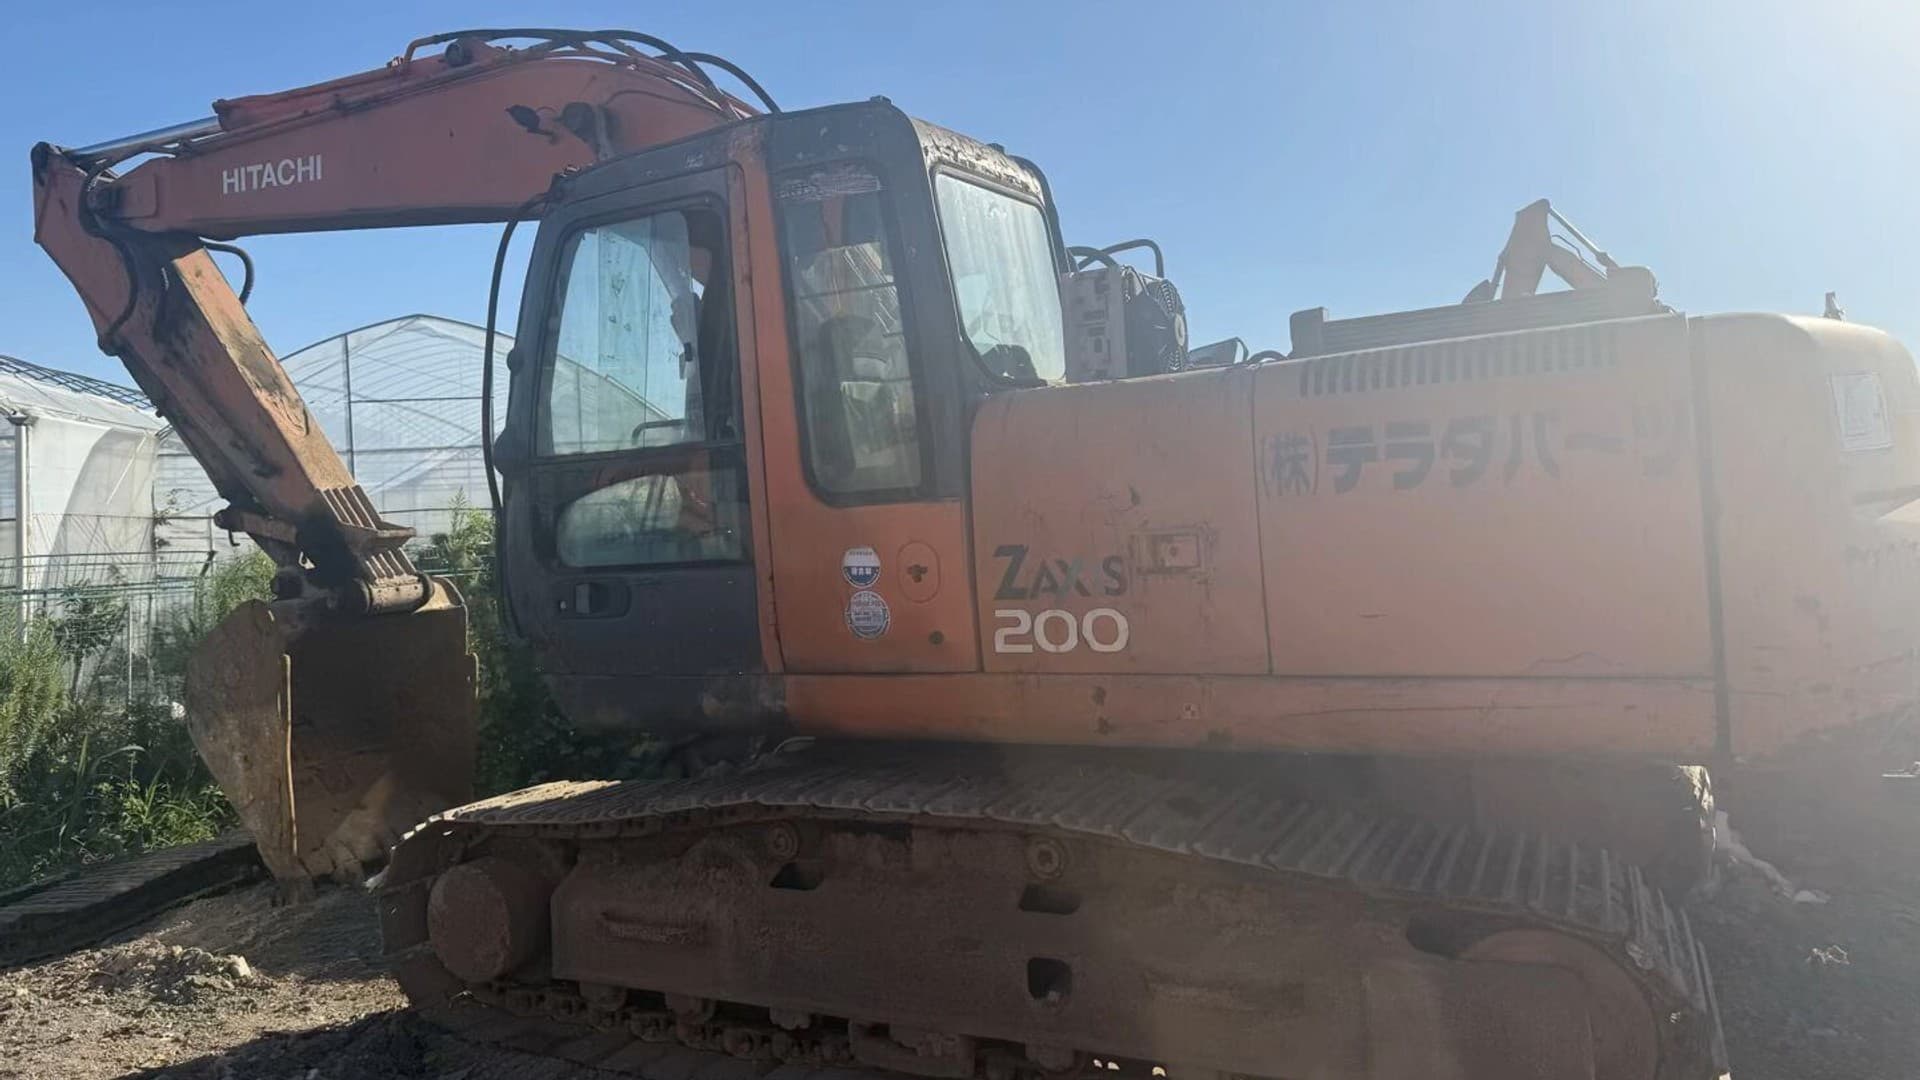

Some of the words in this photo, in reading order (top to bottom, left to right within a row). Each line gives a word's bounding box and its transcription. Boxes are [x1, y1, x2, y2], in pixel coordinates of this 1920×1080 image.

[222, 154, 322, 195] HITACHI
[993, 544, 1128, 601] ZAXS
[994, 608, 1129, 653] 200
